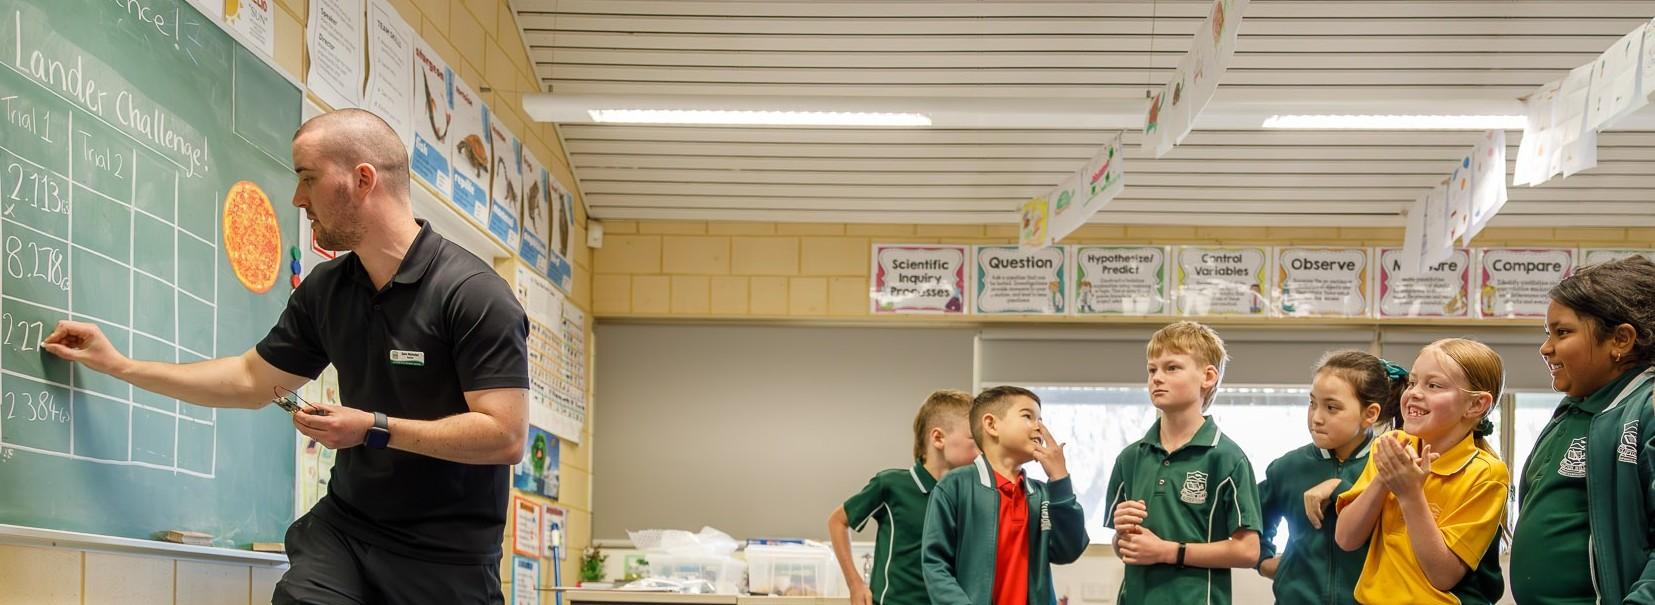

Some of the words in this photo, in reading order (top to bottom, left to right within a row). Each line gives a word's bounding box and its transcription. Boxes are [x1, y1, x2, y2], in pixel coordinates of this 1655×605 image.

[318, 32, 336, 50] Director
[15, 10, 108, 118] Lander
[115, 90, 209, 179] Challenge!
[1, 95, 37, 135] Trial
[41, 110, 53, 144] 1
[79, 129, 111, 171] Trial
[113, 153, 124, 179] 2
[892, 259, 949, 270] Scientific
[989, 257, 1053, 269] Question
[1201, 253, 1243, 264] Control
[1291, 258, 1356, 271] Observe
[1392, 258, 1458, 272] Mure
[1102, 265, 1140, 275] Predict
[1194, 265, 1249, 276] Variables
[1492, 259, 1562, 274] Compare
[898, 273, 942, 285] Inquiry
